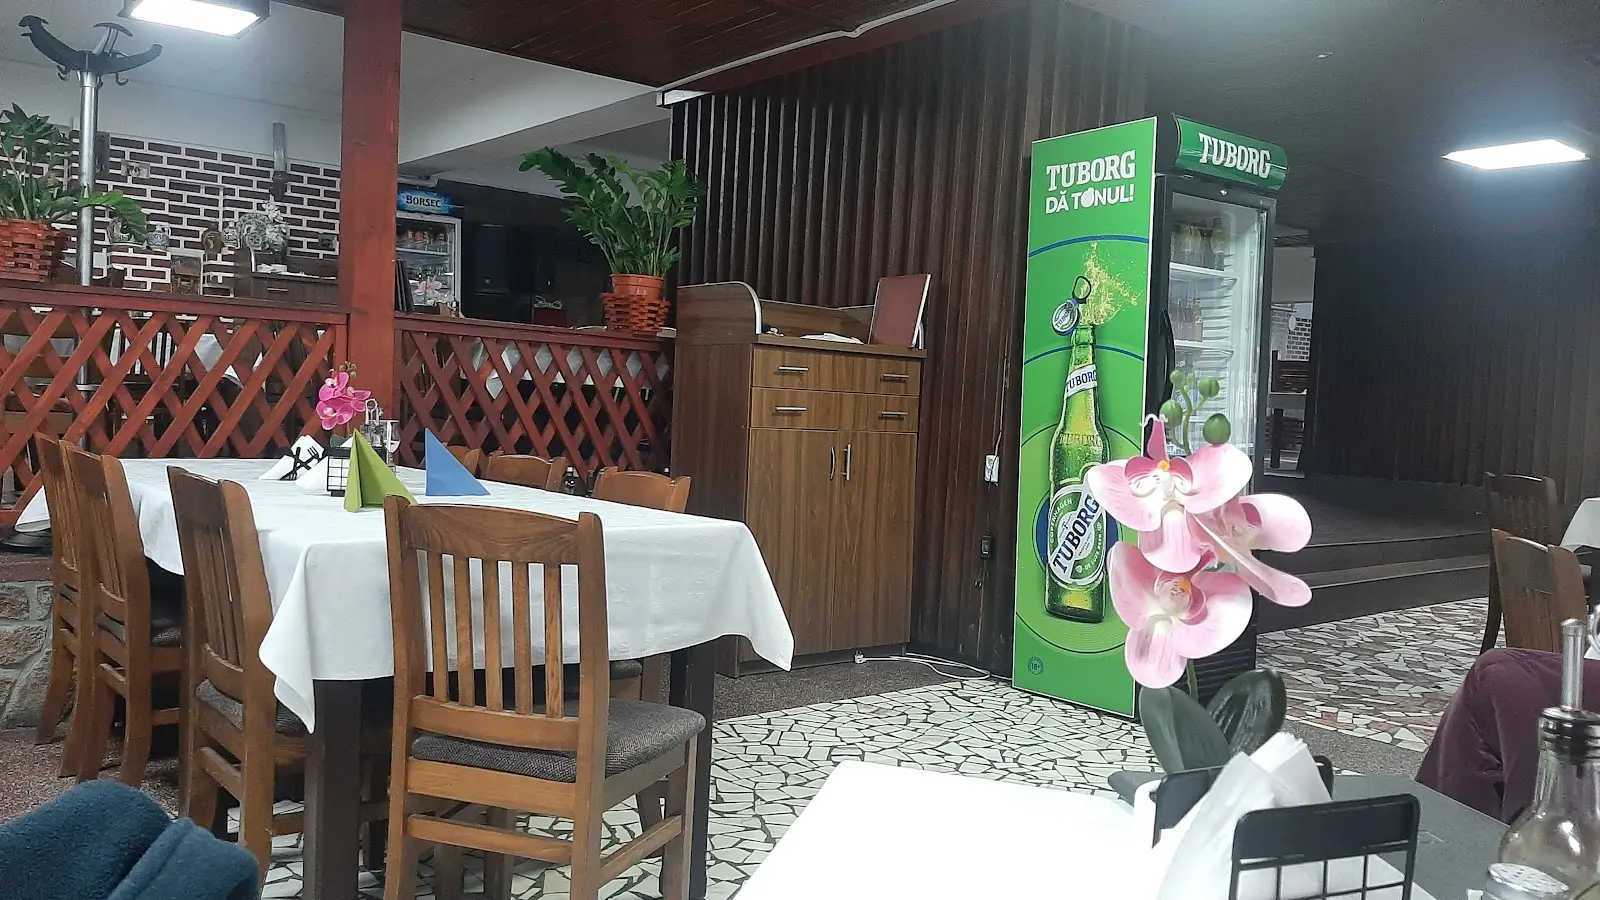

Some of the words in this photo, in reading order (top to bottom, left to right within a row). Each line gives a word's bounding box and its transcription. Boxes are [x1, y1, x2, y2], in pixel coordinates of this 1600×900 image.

[1045, 149, 1136, 192] TUBORG
[1198, 132, 1271, 179] TUBORG
[406, 195, 441, 208] BORSEC
[1045, 190, 1069, 214] DĂ
[1071, 184, 1135, 210] TONUL!
[1050, 497, 1074, 543] COPENHAGEN
[1053, 493, 1100, 574] TUBORG
